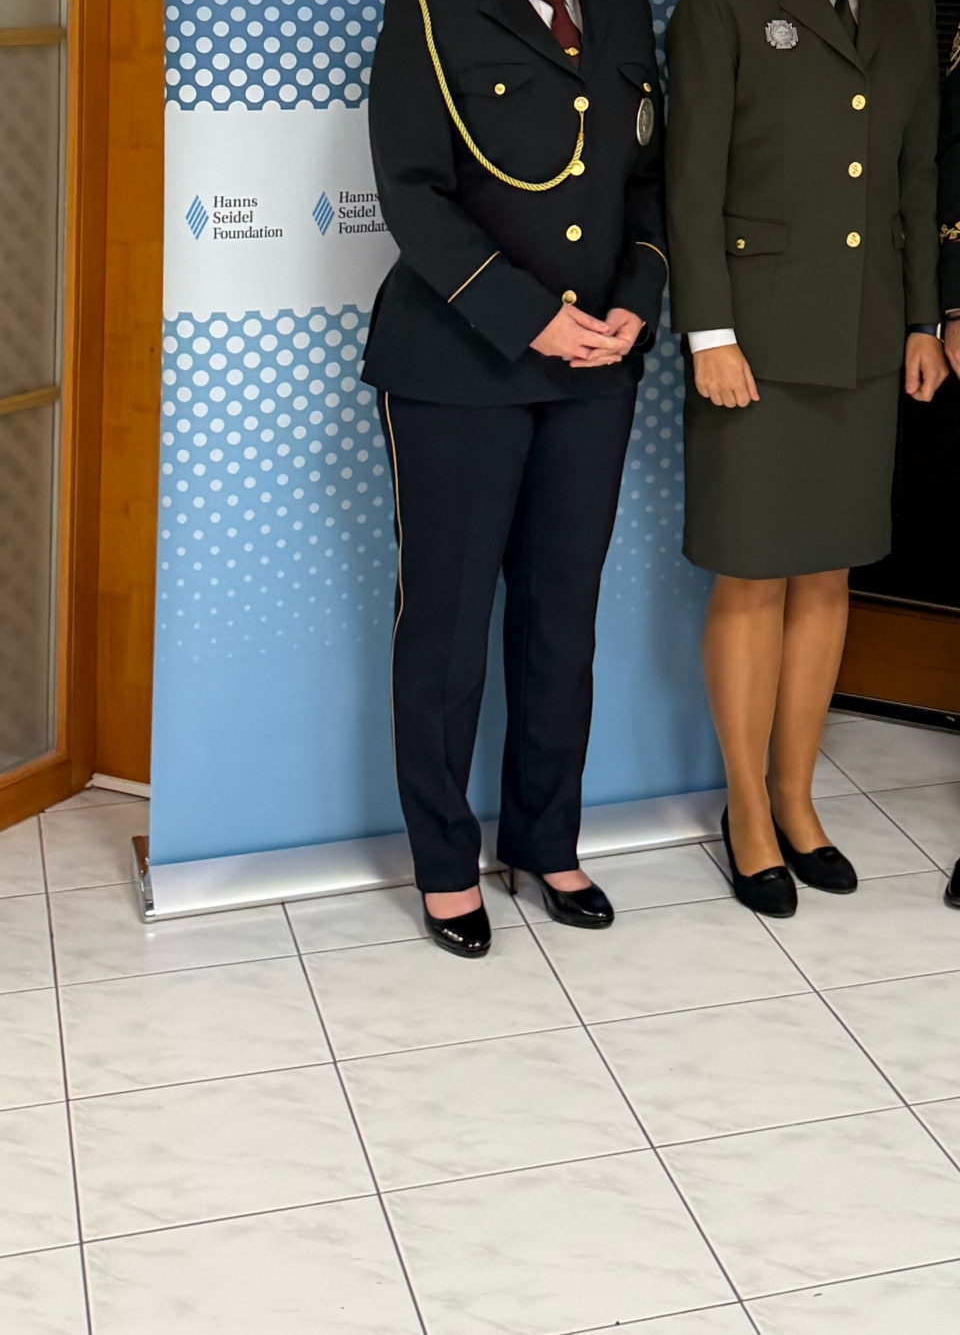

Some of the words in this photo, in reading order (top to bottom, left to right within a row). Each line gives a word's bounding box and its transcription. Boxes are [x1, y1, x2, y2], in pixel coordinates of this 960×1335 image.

[213, 195, 258, 208] Hanns
[339, 191, 379, 204] Hanns
[212, 210, 253, 224] Seidel
[338, 205, 376, 219] Seidel
[212, 226, 283, 240] Foundation
[338, 221, 390, 234] Foundat
